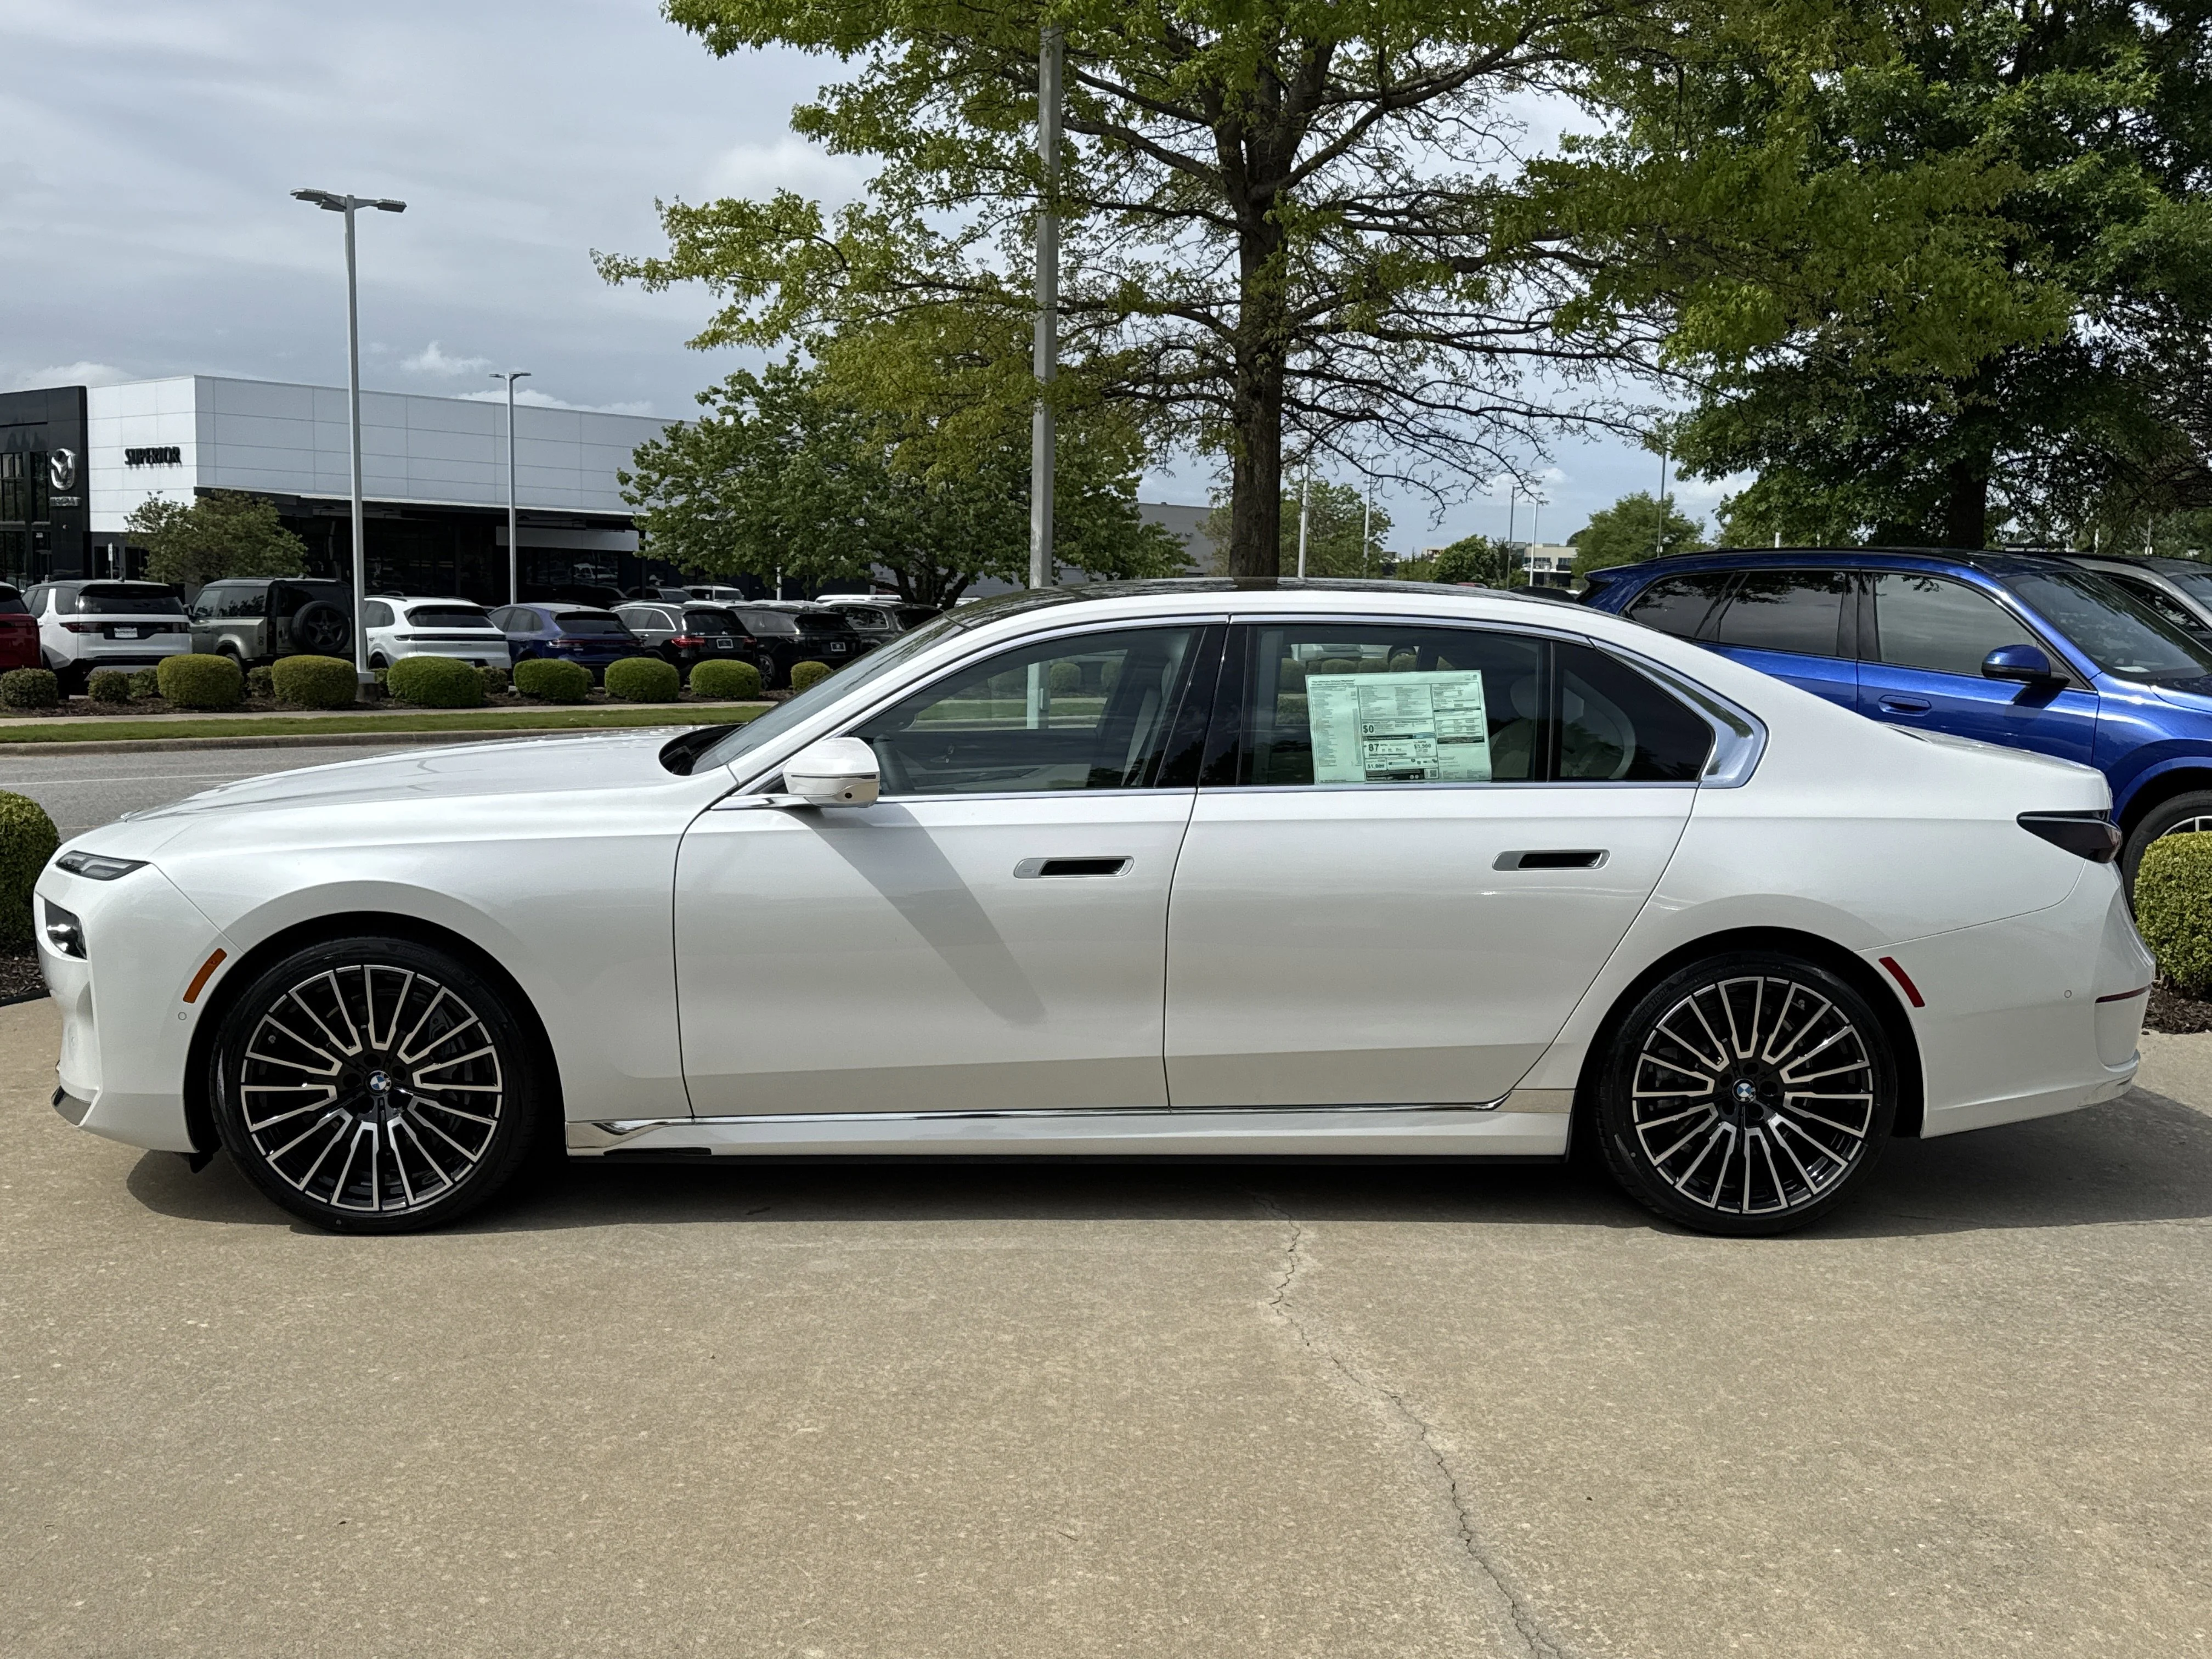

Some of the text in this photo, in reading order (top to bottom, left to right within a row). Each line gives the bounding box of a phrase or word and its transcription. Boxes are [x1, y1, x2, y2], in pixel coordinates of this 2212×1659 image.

[125, 446, 182, 465] SUPERIOR
[1363, 725, 1374, 733] $0
[1368, 743, 1379, 752] 87
